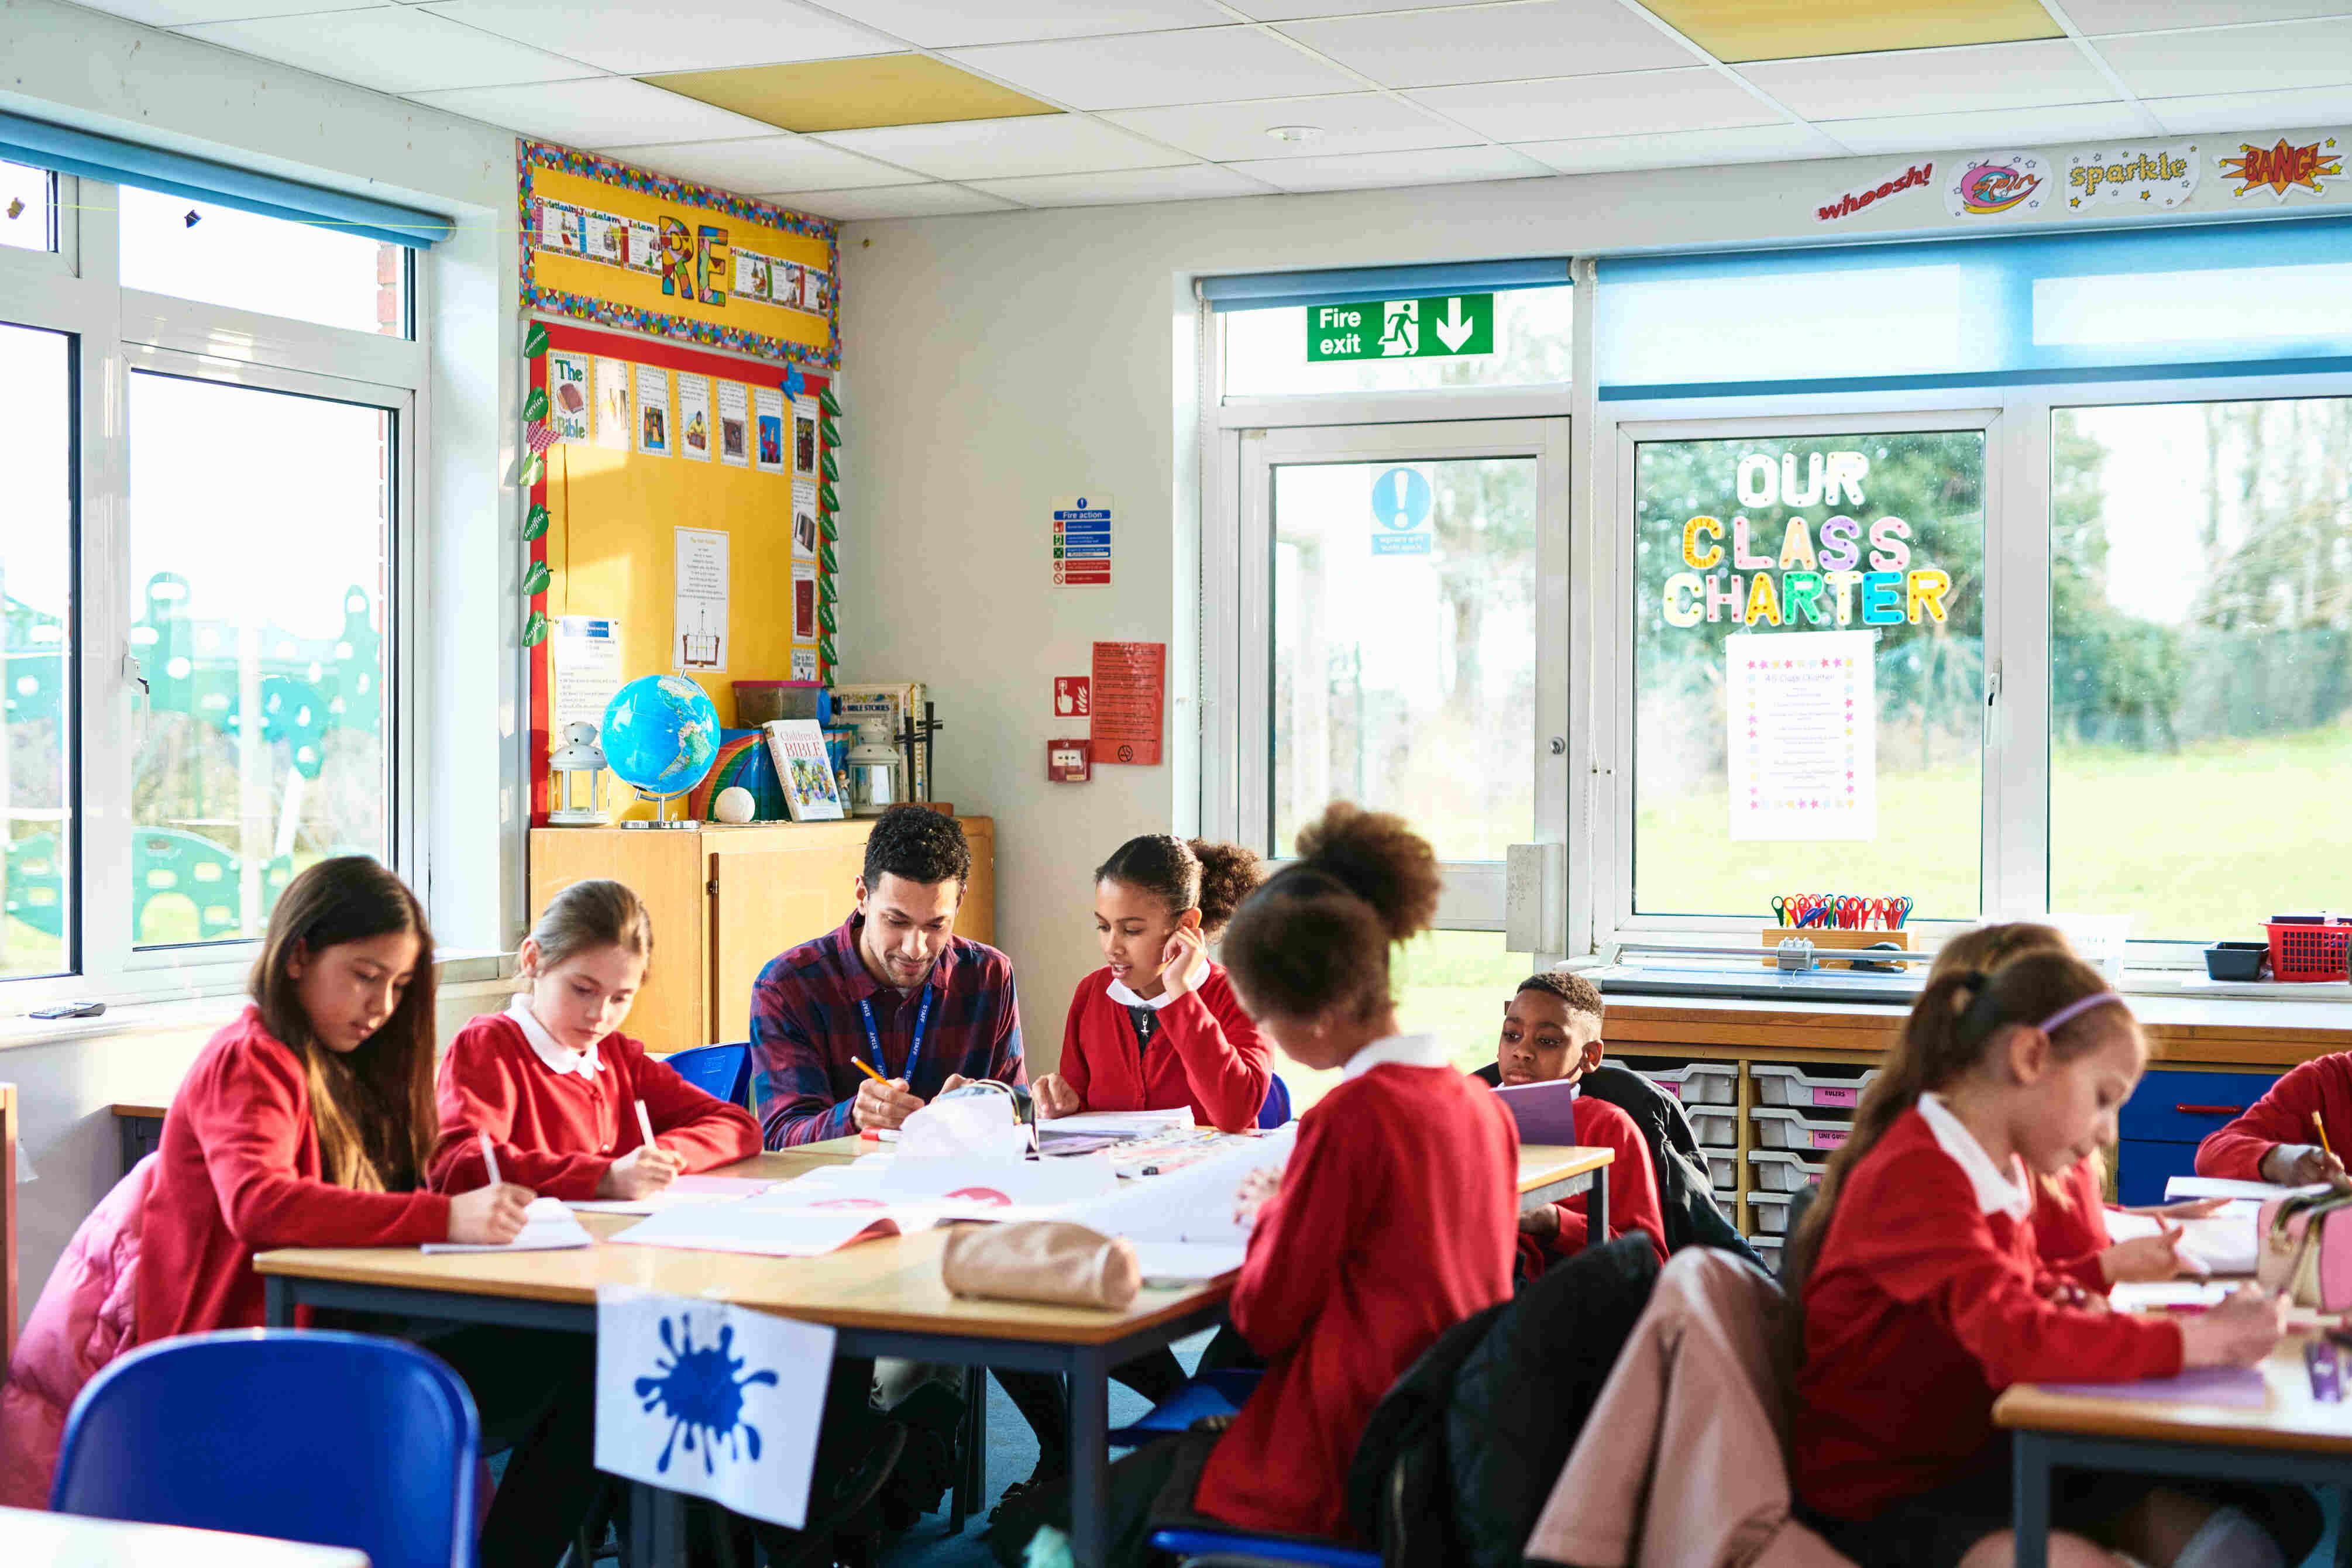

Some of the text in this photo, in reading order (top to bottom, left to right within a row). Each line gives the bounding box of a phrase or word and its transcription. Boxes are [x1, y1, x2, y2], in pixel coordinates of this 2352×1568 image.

[2069, 152, 2187, 196] sparkle
[2245, 146, 2319, 182] BANG!
[1819, 163, 1933, 219] whoosh!
[536, 197, 579, 216] Christianity
[579, 208, 621, 223] Judaism
[628, 219, 655, 233] Islam
[659, 215, 728, 307] RE
[1319, 308, 1361, 328] Fire
[1319, 333, 1361, 355] exit
[555, 359, 583, 382] The
[527, 396, 544, 417] service
[557, 416, 585, 439] Bible
[1737, 451, 1869, 508] OUR
[525, 513, 544, 538] sacrifice
[1683, 515, 1911, 572] CLASS
[1663, 569, 1951, 628] CHARTER
[525, 618, 544, 644] justice
[780, 729, 819, 741] Children's
[785, 741, 823, 757] BIBLE
[861, 999, 871, 1017] STAFF
[869, 1031, 878, 1050] STAFF
[913, 1037, 921, 1056] STAFF
